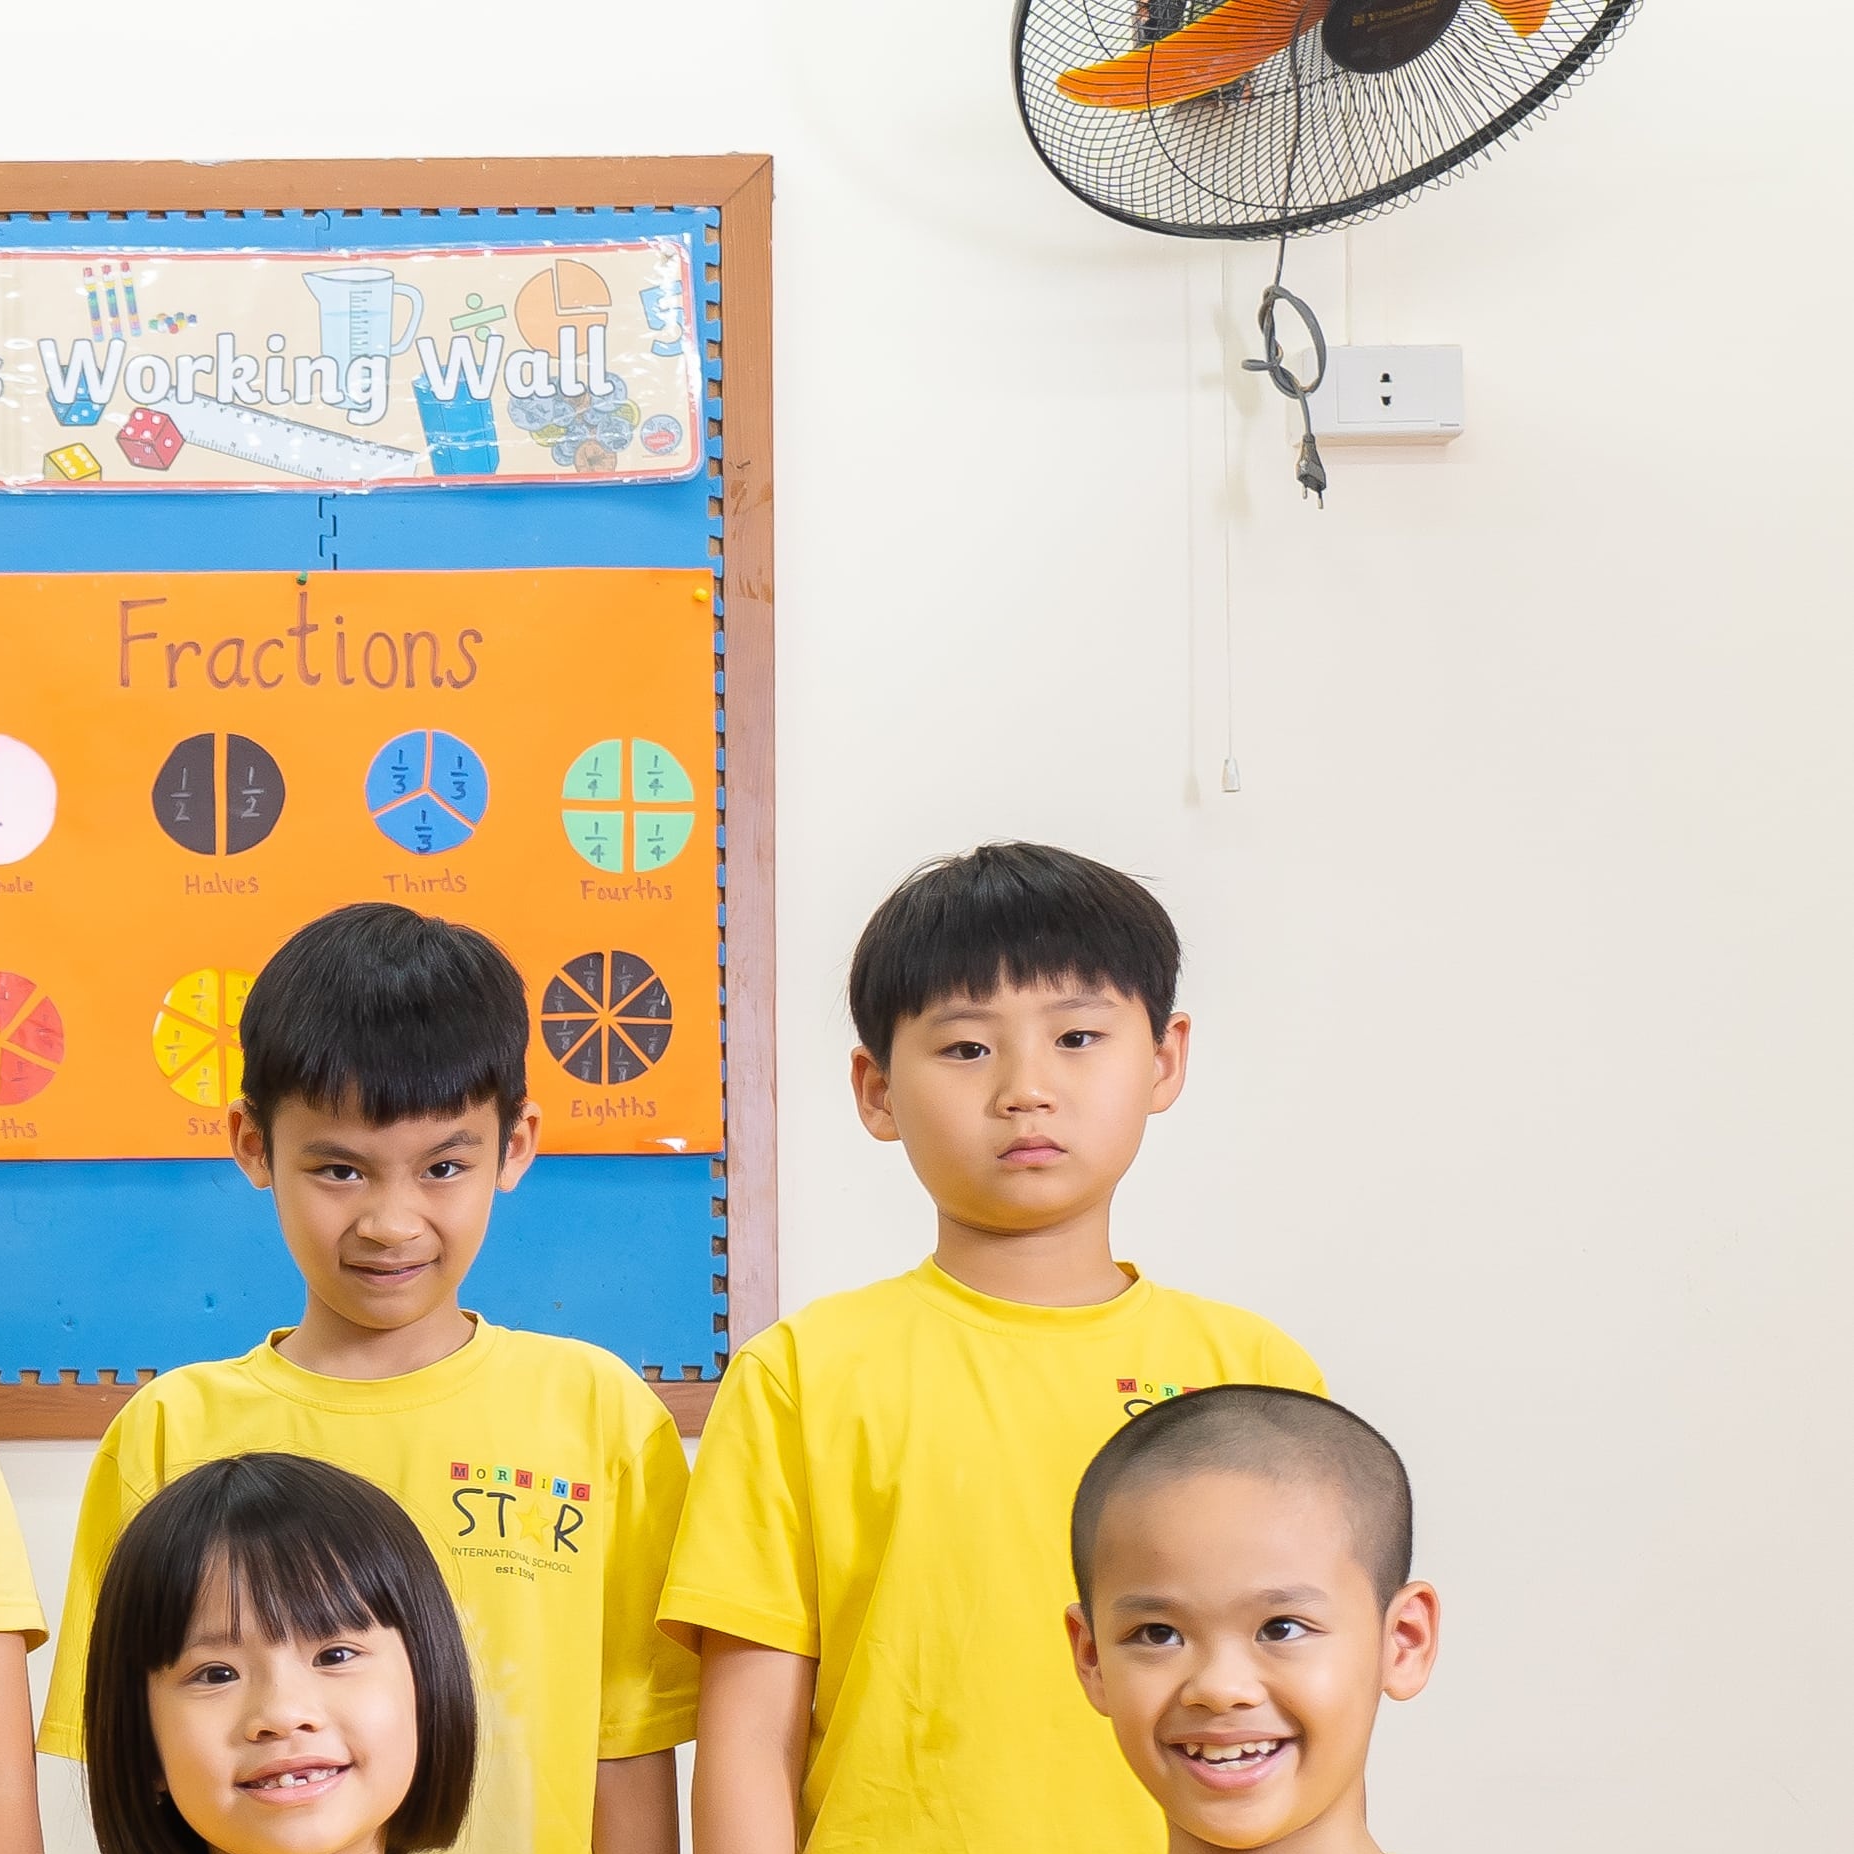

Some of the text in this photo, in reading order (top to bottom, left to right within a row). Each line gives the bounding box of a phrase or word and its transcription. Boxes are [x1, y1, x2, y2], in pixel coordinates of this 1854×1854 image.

[37, 333, 389, 426] Working
[416, 325, 615, 401] Wall
[119, 591, 483, 689] Fractions
[185, 873, 260, 895] Halves
[382, 869, 467, 895] Thirds
[580, 878, 673, 901] Fourths
[571, 1096, 657, 1126] Eighths
[452, 1465, 588, 1500] MORNING
[532, 1558, 573, 1574] SCHOOL
